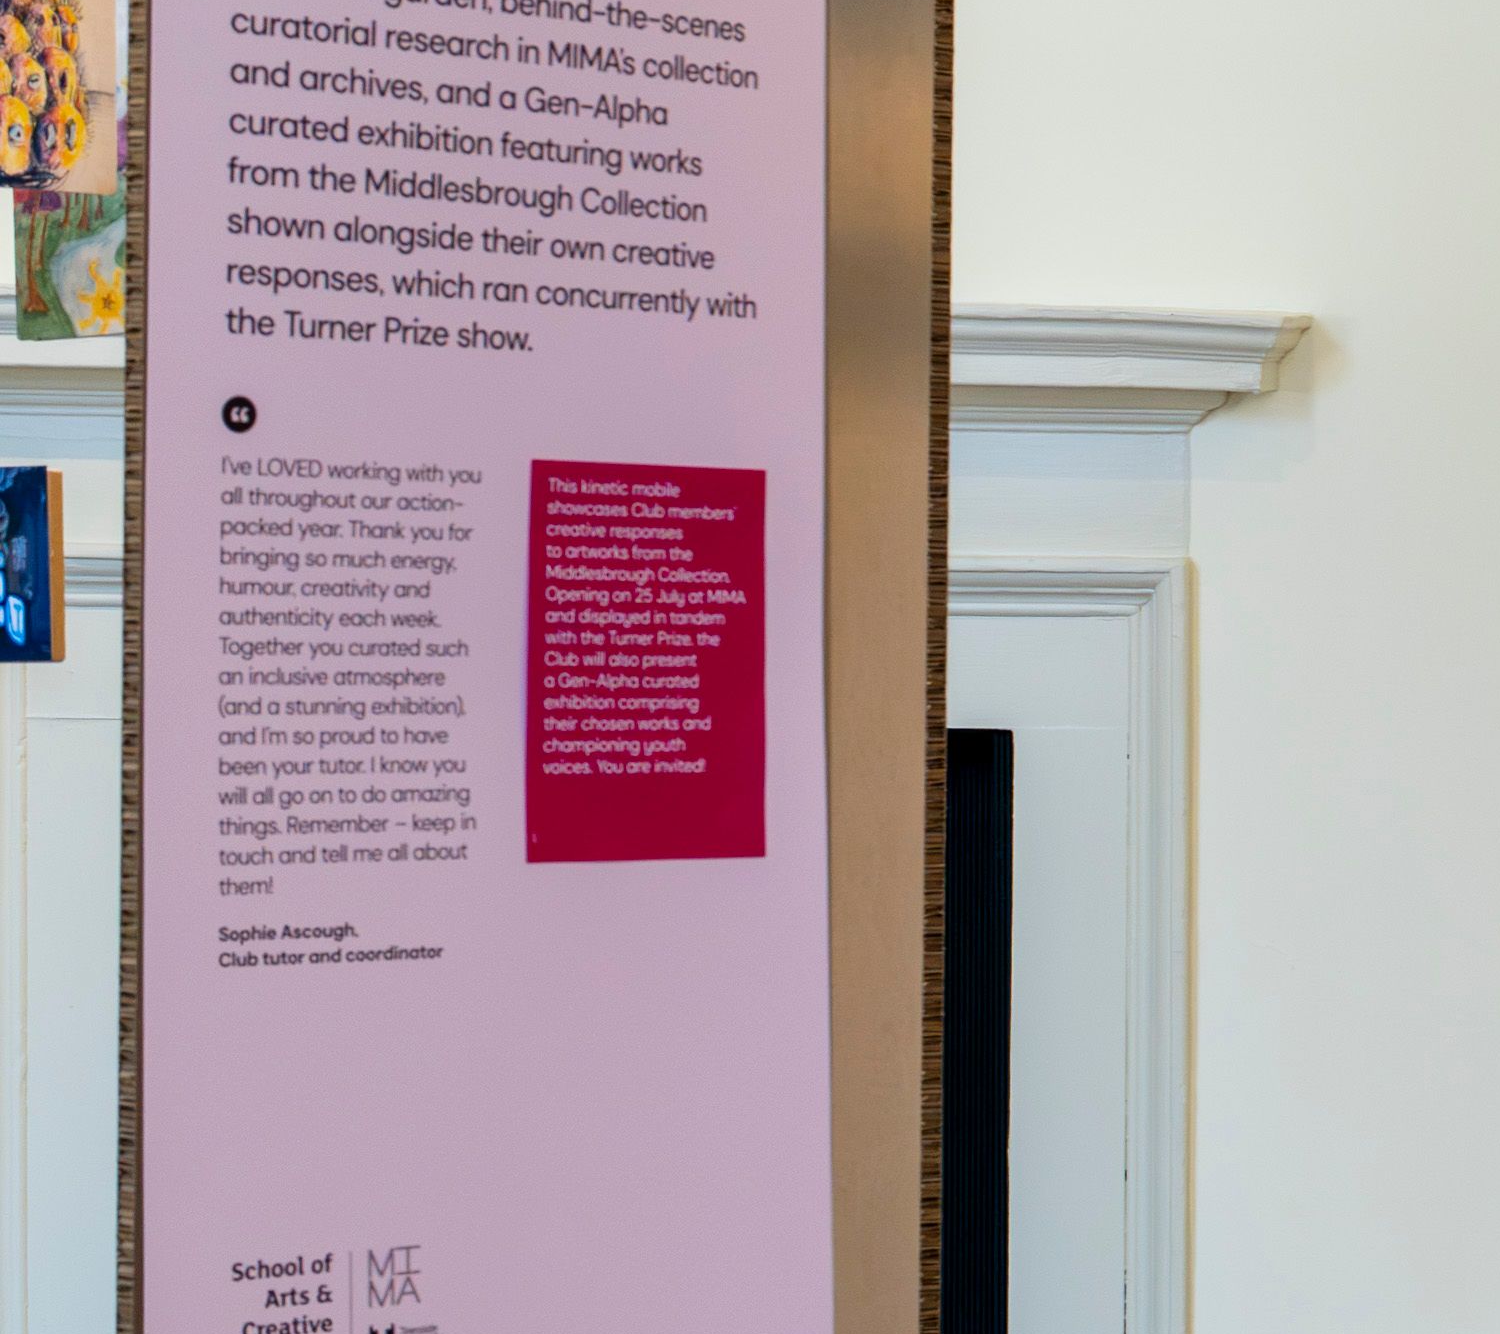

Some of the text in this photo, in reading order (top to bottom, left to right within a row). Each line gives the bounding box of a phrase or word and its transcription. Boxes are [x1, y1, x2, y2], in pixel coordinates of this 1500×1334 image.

[230, 12, 377, 48] curatorial
[385, 29, 510, 62] research
[517, 36, 541, 65] in
[642, 54, 759, 89] collection
[229, 60, 668, 129] and archives, and a Gen-Alpha
[229, 113, 703, 177] curated exhibition featuring works
[227, 155, 707, 223] from the Middlesbrough Collection
[227, 206, 715, 270] shown alongside their own creative
[226, 263, 757, 322] responses, which ran concurrently with
[225, 306, 533, 352] the Turner Prize show.
[257, 457, 324, 479] LOVED
[327, 461, 402, 487] working
[405, 463, 444, 483] with
[448, 469, 482, 488] you
[220, 486, 243, 505] all
[248, 487, 357, 514] throughout
[360, 495, 393, 511] our
[219, 636, 470, 661] Together you curated such
[218, 842, 468, 866] touch and tell me all about
[218, 924, 278, 946] Sophie
[218, 945, 444, 968] Club tutor and coordinator
[231, 1254, 333, 1282] School of
[264, 1284, 333, 1309] Arts &
